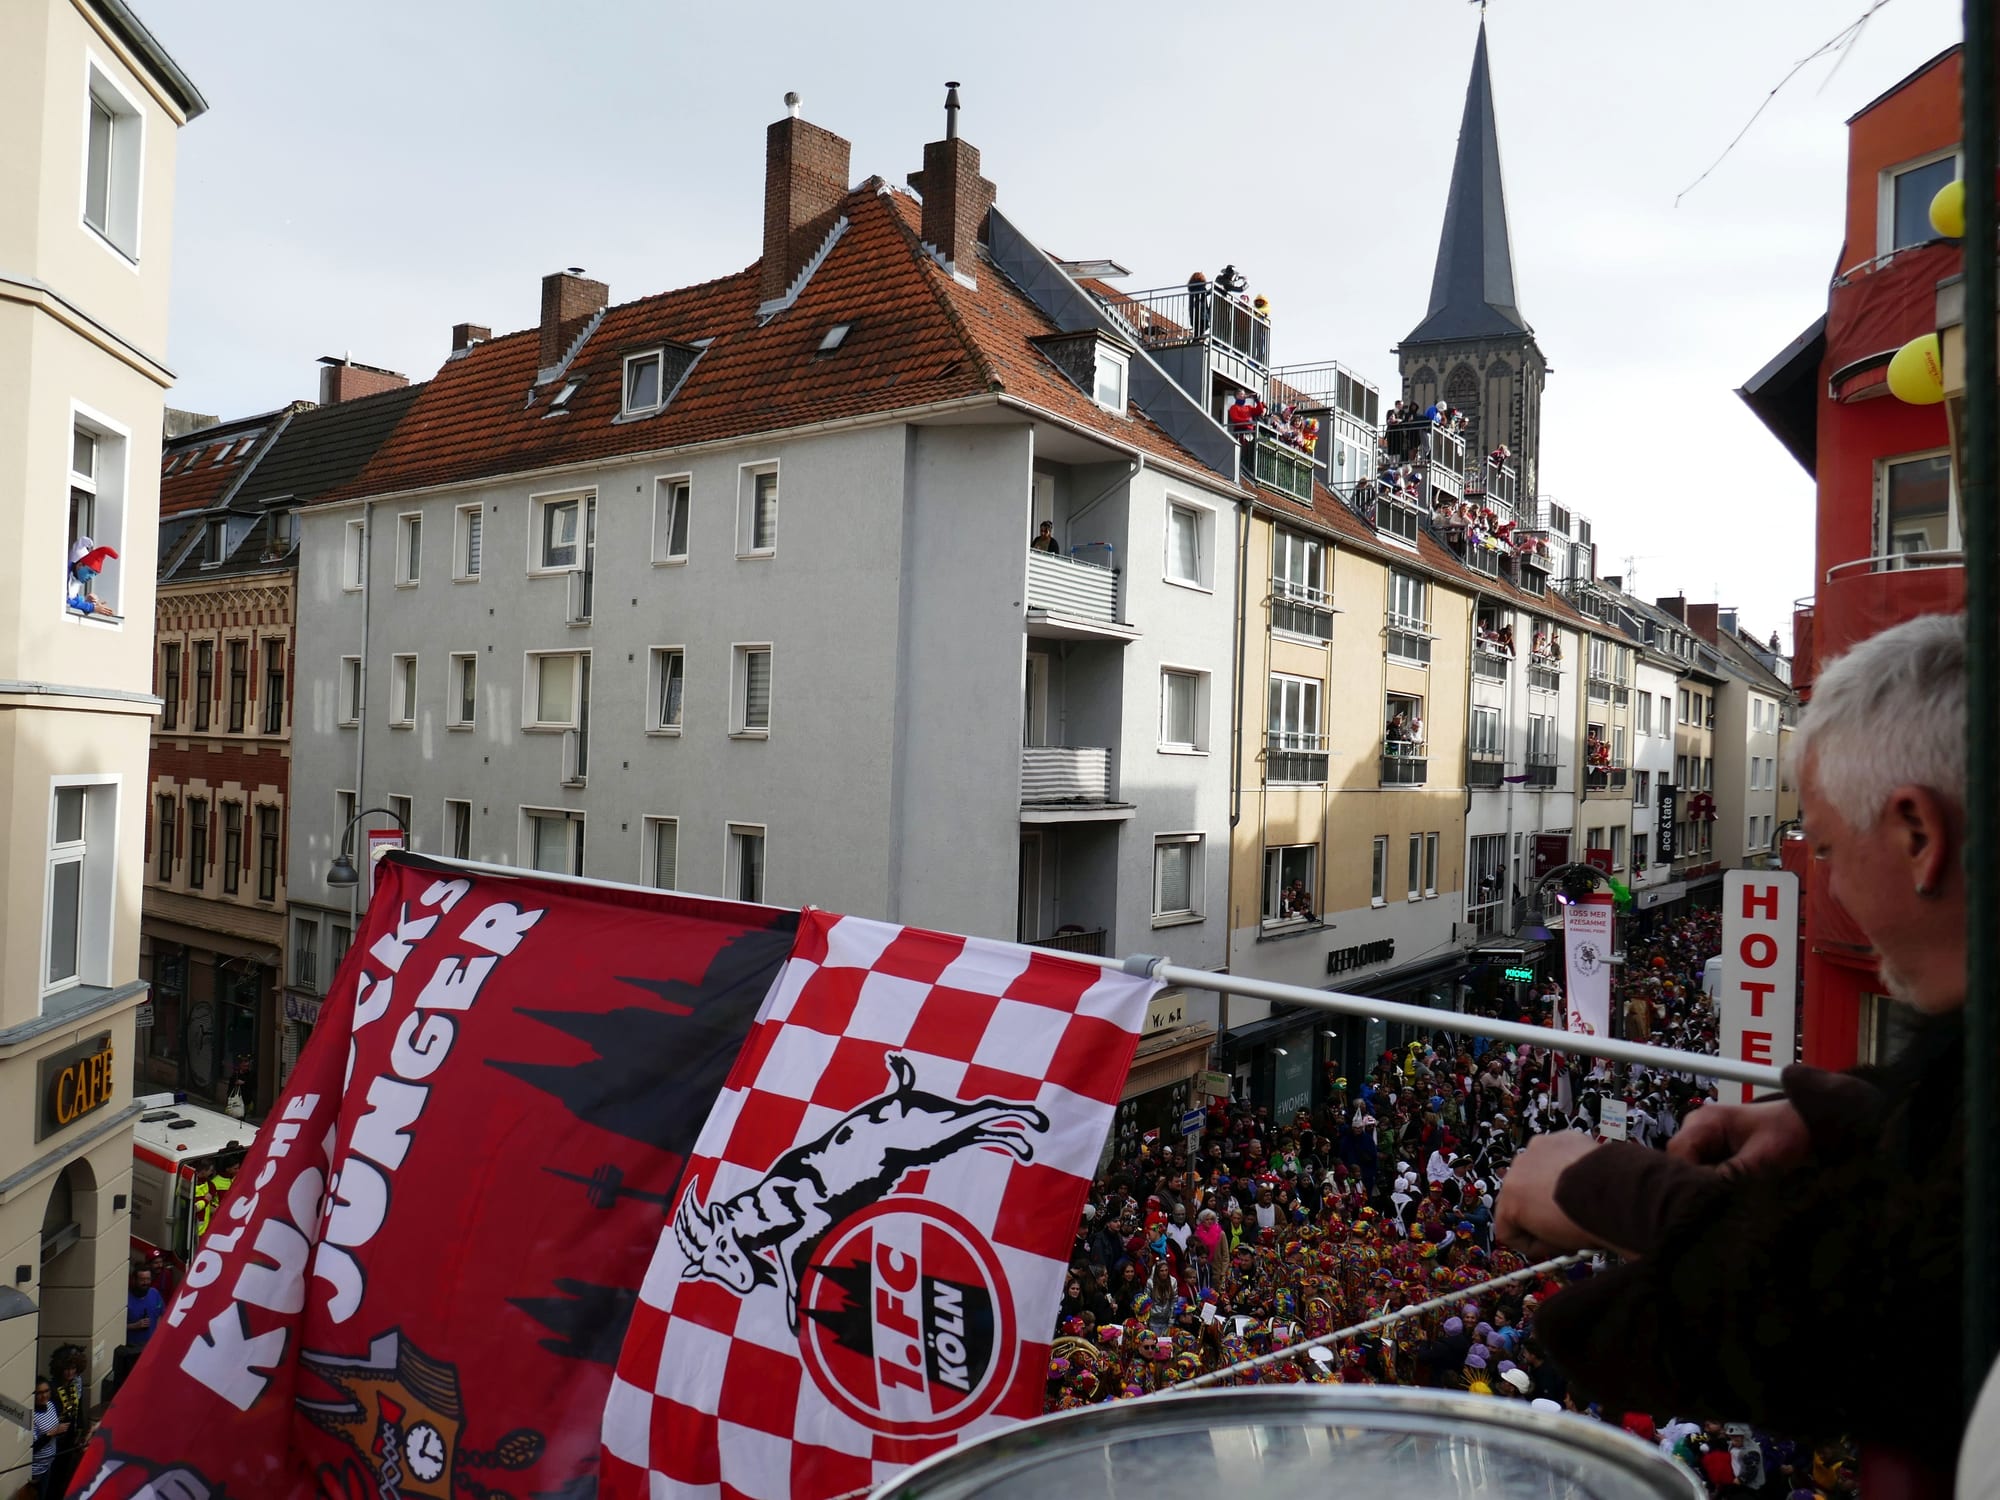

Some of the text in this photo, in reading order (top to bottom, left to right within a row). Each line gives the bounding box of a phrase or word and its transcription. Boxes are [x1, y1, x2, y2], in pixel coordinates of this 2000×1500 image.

[1661, 797, 1672, 851] ace & tate
[1327, 938, 1395, 974] KEEPLOVING
[1505, 968, 1533, 979] KIOSK
[57, 1037, 114, 1125] CAFÉ
[1277, 1089, 1309, 1115] #WOMEN
[313, 902, 545, 1324] JÜNGER
[927, 1280, 970, 1391] KÖLN
